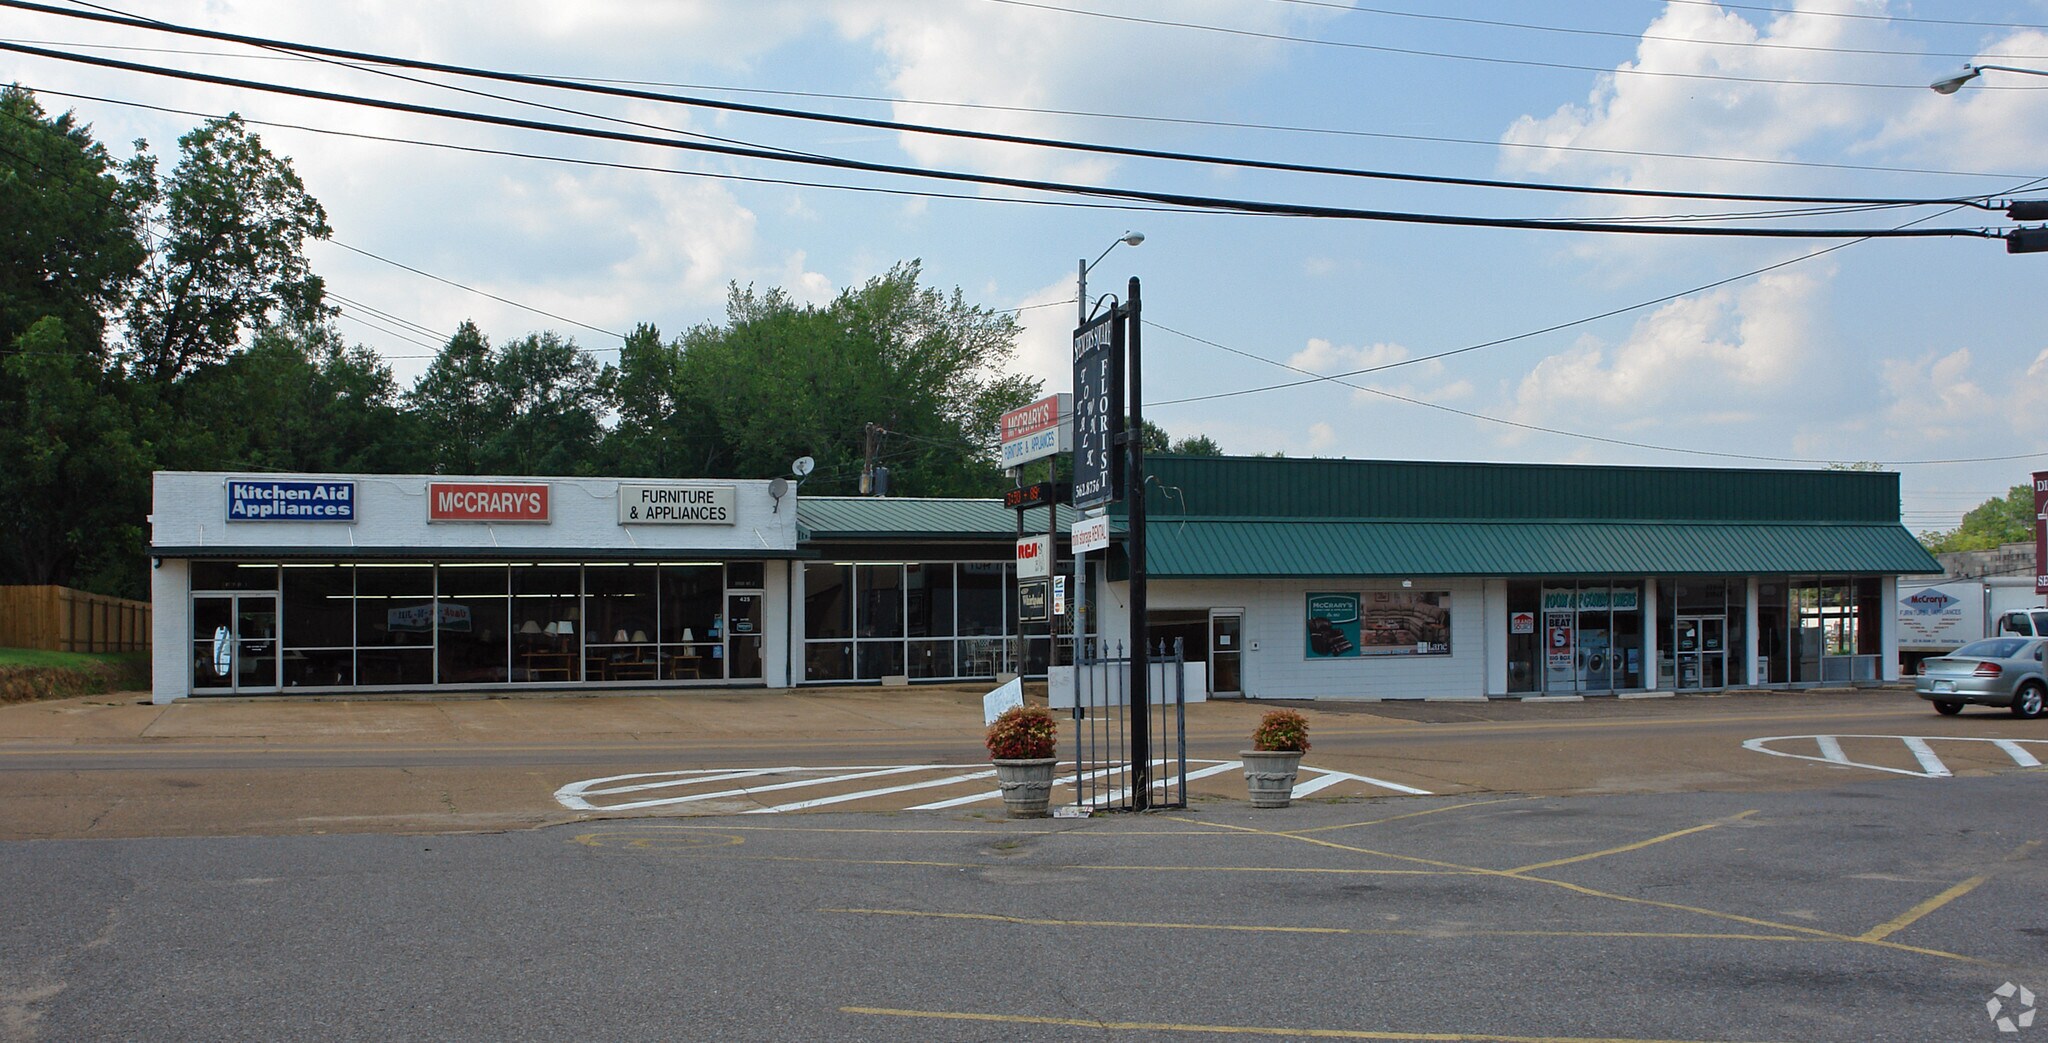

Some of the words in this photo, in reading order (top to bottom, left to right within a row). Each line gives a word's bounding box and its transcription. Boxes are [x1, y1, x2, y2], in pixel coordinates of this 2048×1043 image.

[1100, 359, 1108, 487] FLORIST
[1025, 440, 1029, 453] &
[1031, 431, 1054, 452] APPLIANCES
[642, 490, 714, 504] FURNITURE
[232, 500, 351, 517] Appliances
[629, 505, 639, 520] &
[646, 506, 726, 521] APPLIANCES
[1018, 542, 1037, 560] RCA
[1911, 595, 1948, 608] McCrary's
[1549, 618, 1571, 627] BEAT
[1428, 642, 1447, 651] Lane
